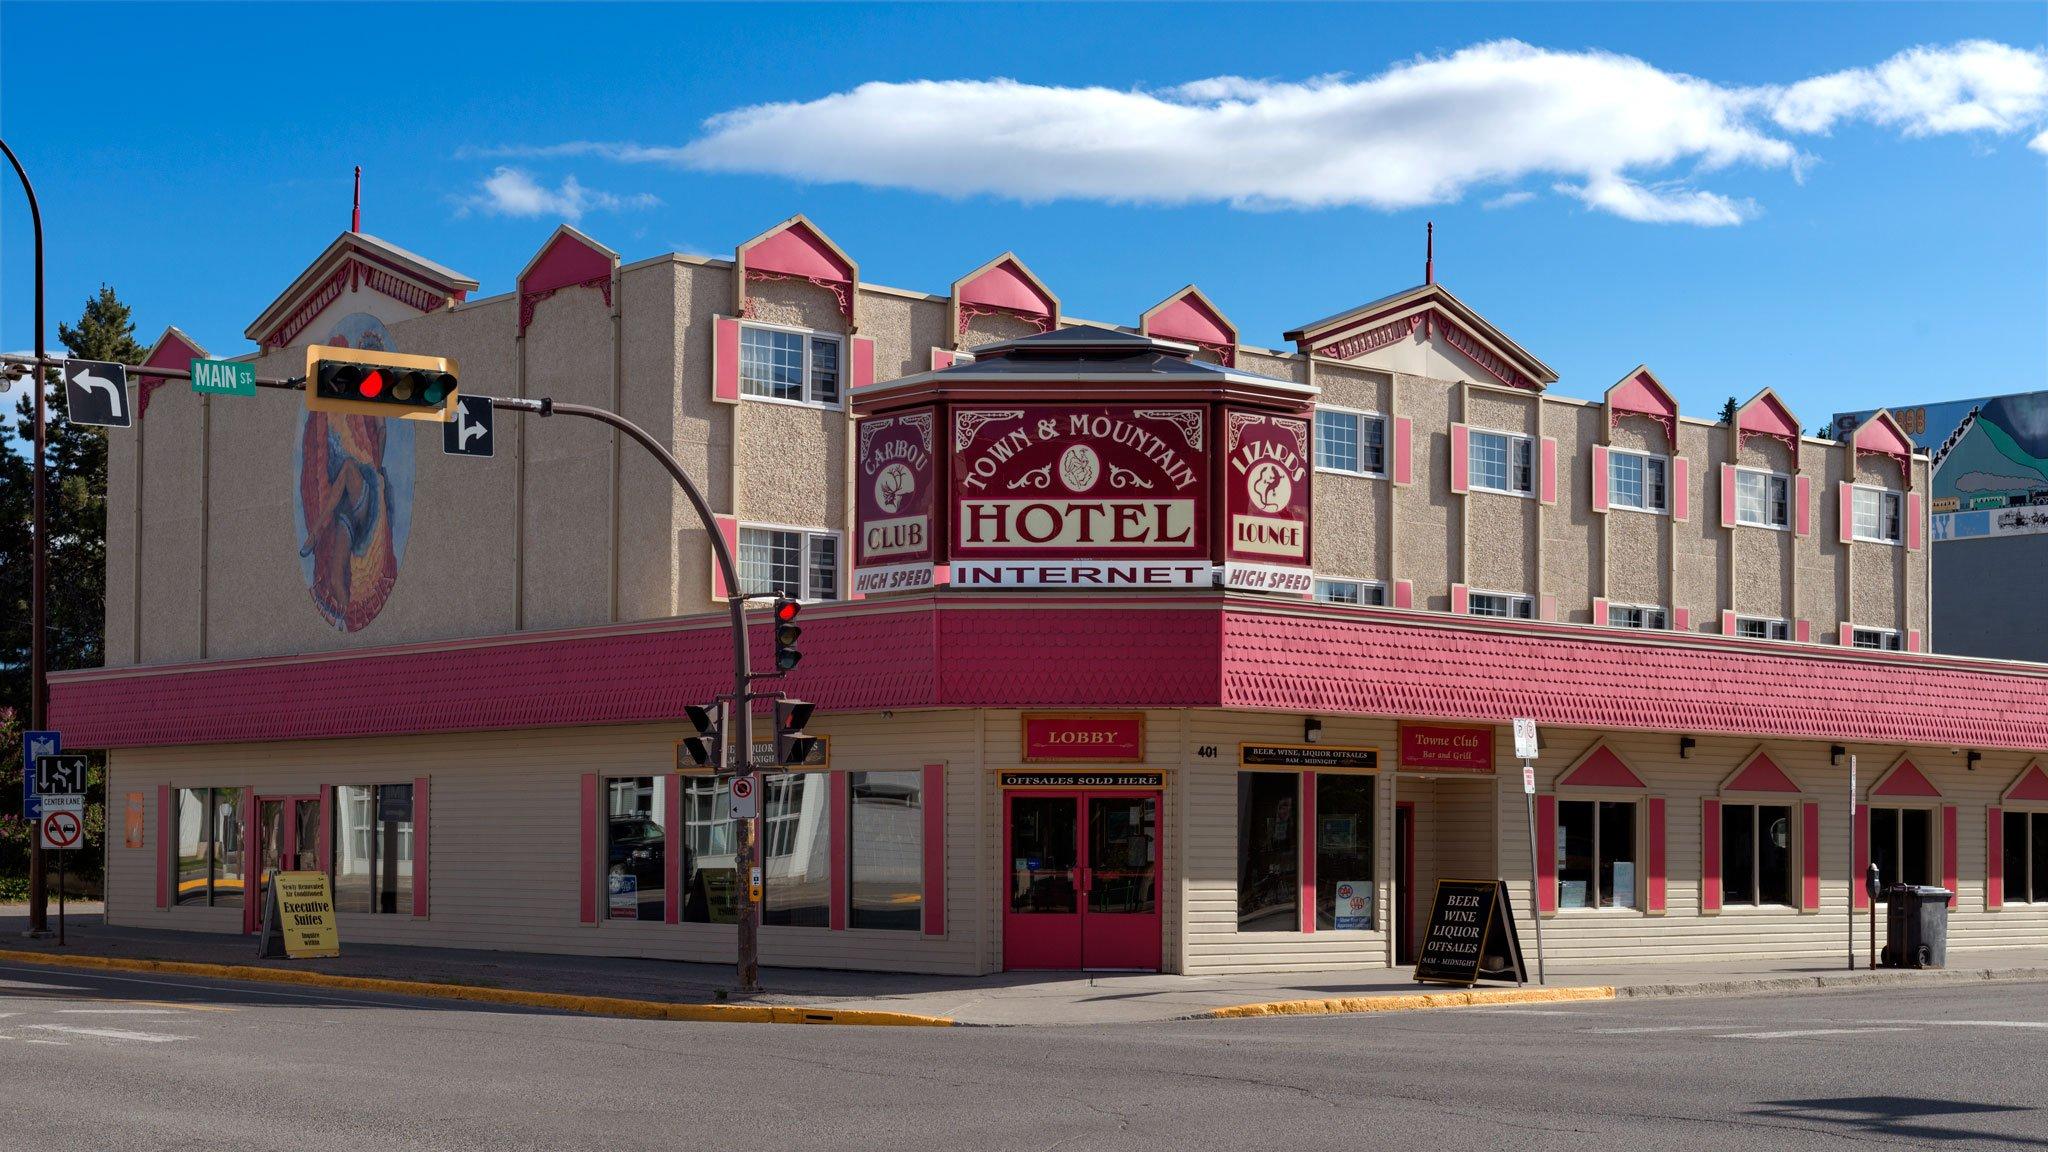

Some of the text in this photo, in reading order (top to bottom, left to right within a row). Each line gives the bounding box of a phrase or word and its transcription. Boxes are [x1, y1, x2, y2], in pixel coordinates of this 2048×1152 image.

[195, 363, 237, 389] MAIN
[864, 439, 928, 475] CARIBOU
[962, 414, 1197, 491] TOWN & MOUNTAIN
[1231, 439, 1307, 483] LIZARDS
[966, 503, 1191, 543] HOTEL
[868, 523, 922, 550] CLUB
[1238, 522, 1300, 547] LOUNGE
[856, 568, 932, 591] HIGH SPEED
[957, 567, 1204, 584] INTERNET
[1229, 568, 1311, 591] HIGH SPEED
[1049, 731, 1118, 744] LOBBY
[1415, 734, 1478, 747] Towne Club
[1197, 746, 1218, 758] 401
[1253, 748, 1276, 756] BEER,
[1302, 750, 1331, 758] LIQUOR
[1332, 751, 1368, 759] OFFSALES
[1437, 751, 1451, 759] and
[1453, 751, 1473, 760] Grill
[1007, 777, 1157, 785] OFFSALES SOLD HERE
[43, 797, 81, 806] CENTER LANE
[284, 901, 329, 913] Executive
[1447, 895, 1480, 907] BEER
[294, 913, 323, 926] Suites
[1444, 910, 1477, 922] WINE
[1433, 925, 1480, 939] LIQUOR
[1427, 941, 1478, 953] OFFSALES
[1441, 958, 1477, 967] MIDNIGHT
